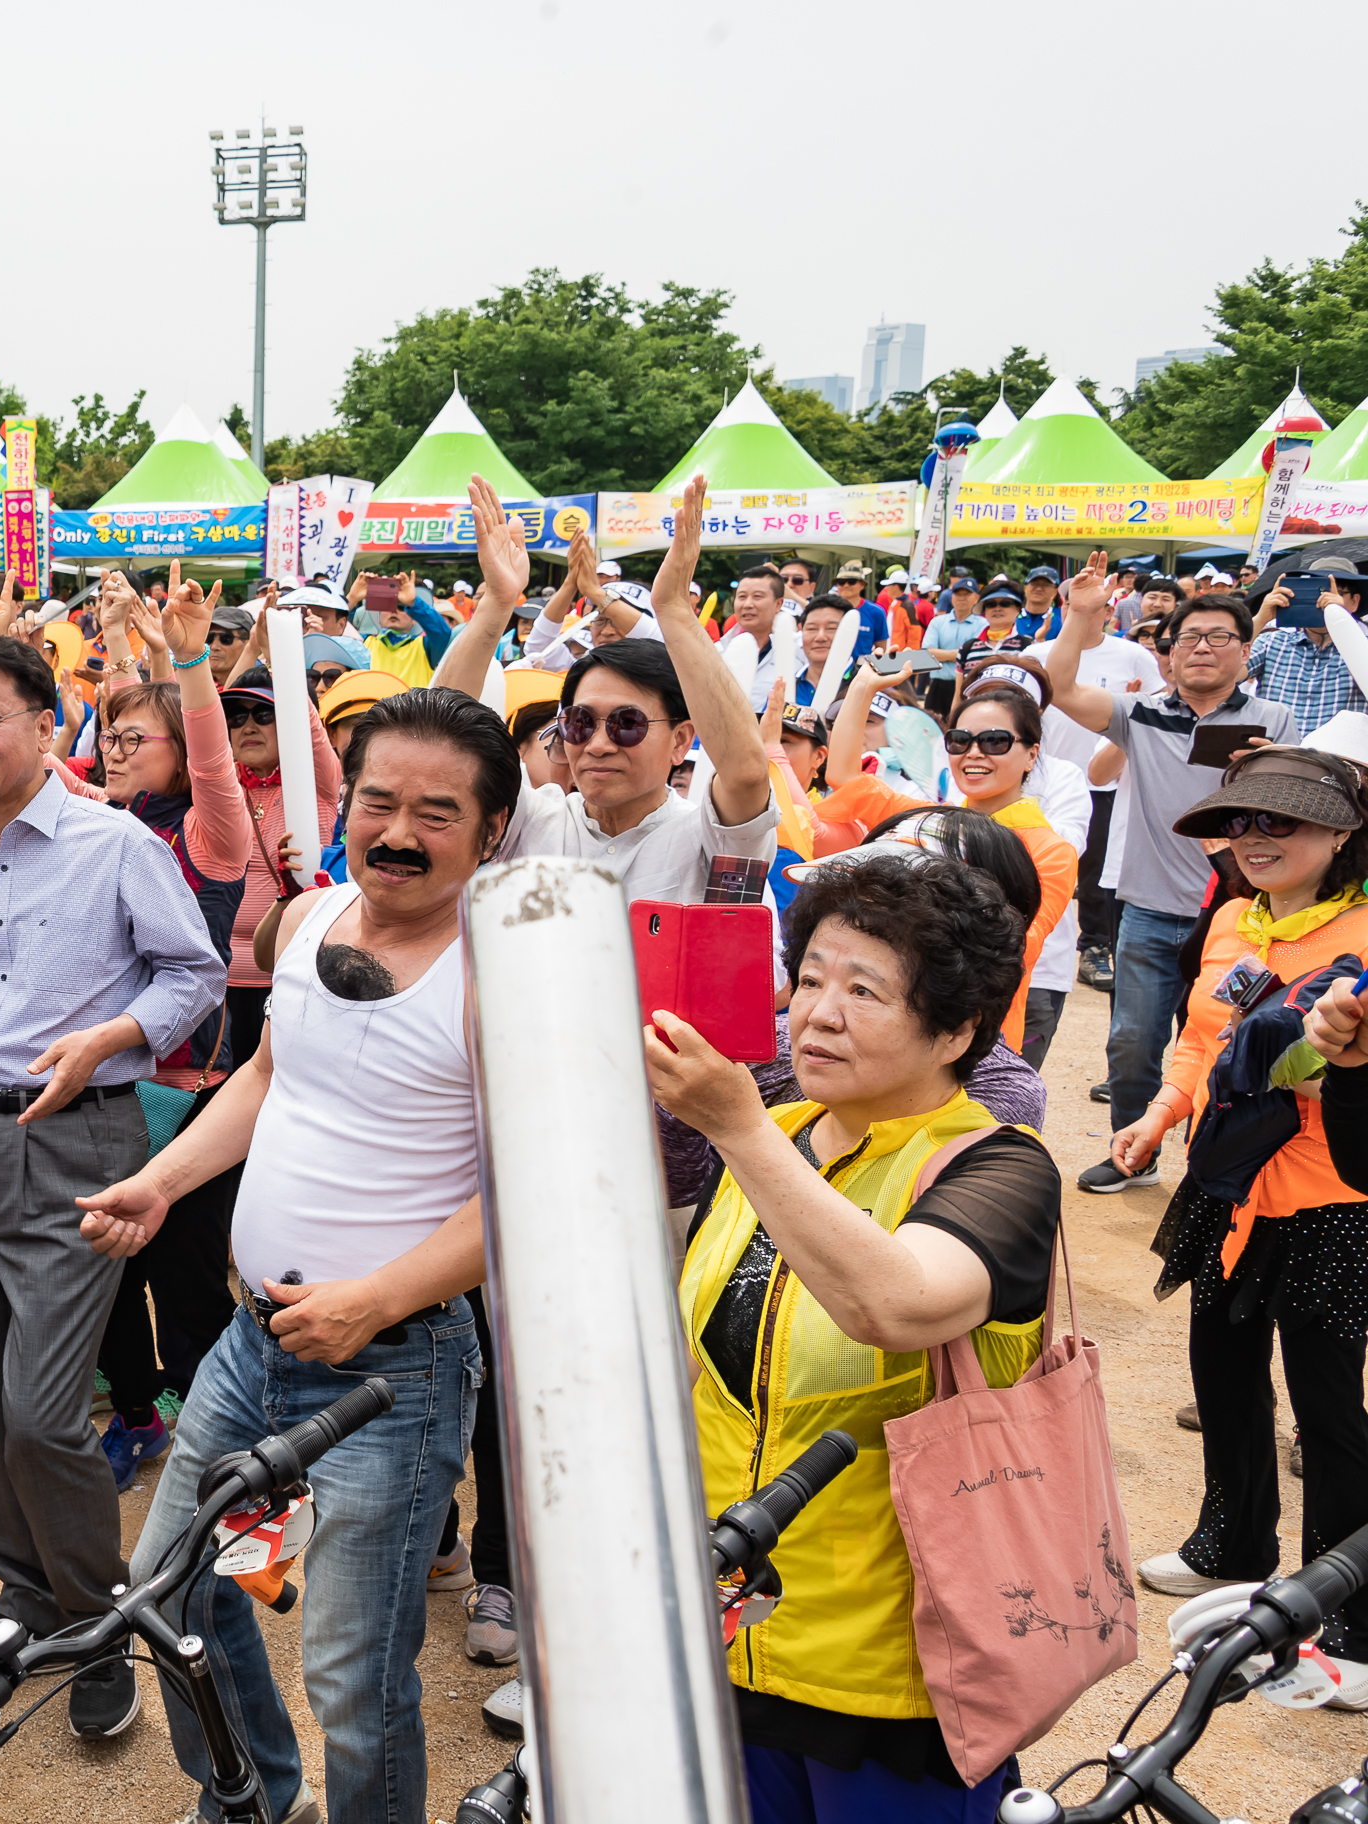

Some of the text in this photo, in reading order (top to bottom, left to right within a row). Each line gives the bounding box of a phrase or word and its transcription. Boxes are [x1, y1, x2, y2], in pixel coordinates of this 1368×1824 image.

[13, 433, 29, 490] 천하무적
[346, 488, 355, 504] I
[992, 483, 1191, 498] 대한민국 최고 광진구, 광진구 주역 자양2동
[1267, 468, 1294, 523] 함께하는
[1025, 504, 1076, 521] 높이는
[1086, 500, 1168, 524] 자양2동
[1175, 498, 1235, 519] 파이팅
[52, 527, 91, 544] Only
[141, 529, 186, 542] First
[282, 508, 295, 571] 구삼마을
[402, 519, 447, 543] 제일
[950, 1465, 1045, 1497] Animal Drawing
